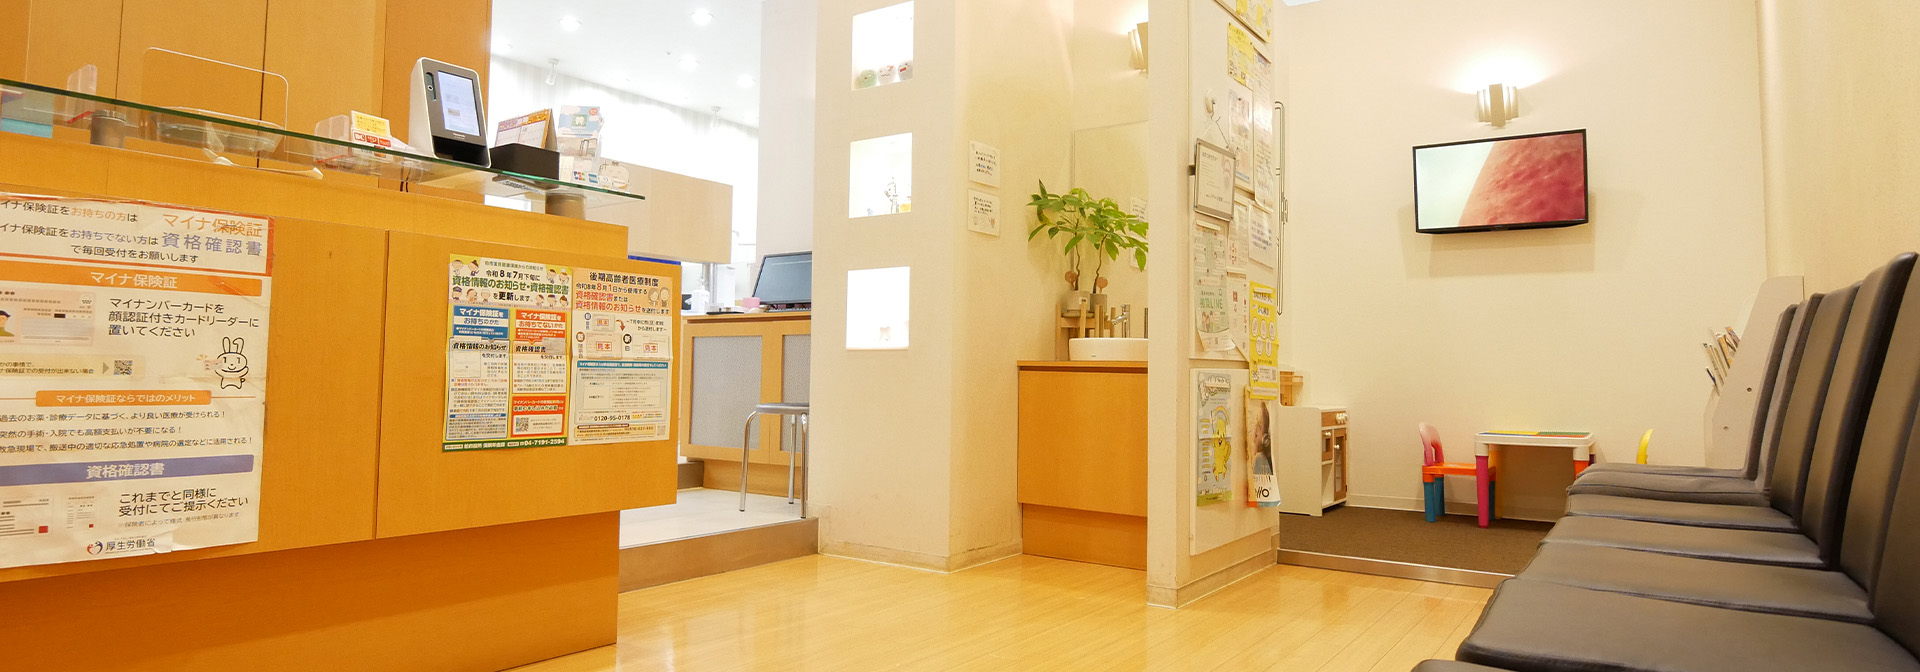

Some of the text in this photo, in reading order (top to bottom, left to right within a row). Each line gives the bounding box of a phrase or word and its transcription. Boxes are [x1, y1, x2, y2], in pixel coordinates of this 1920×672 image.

[162, 213, 263, 237] マイナ保険証
[162, 232, 263, 256] 資格確認書
[71, 244, 199, 264] で毎回受付をお願いします
[90, 271, 178, 289] マイナ保険証
[452, 275, 569, 296] 資格情報のお知らせ・資格確認書
[589, 271, 659, 287] 後期高齢者医療制度
[110, 298, 224, 314] マイナンバーカードを
[109, 311, 259, 328] 顔認証付きカードリーダーに
[109, 324, 195, 338] 置いてください
[56, 393, 196, 404] マイナ保険証ならではのメリット
[86, 462, 165, 480] 資格確認書
[119, 487, 217, 505] これまでと同様に
[118, 497, 249, 517] 受付にてご提示ください
[105, 538, 156, 552] 厚生労働省
